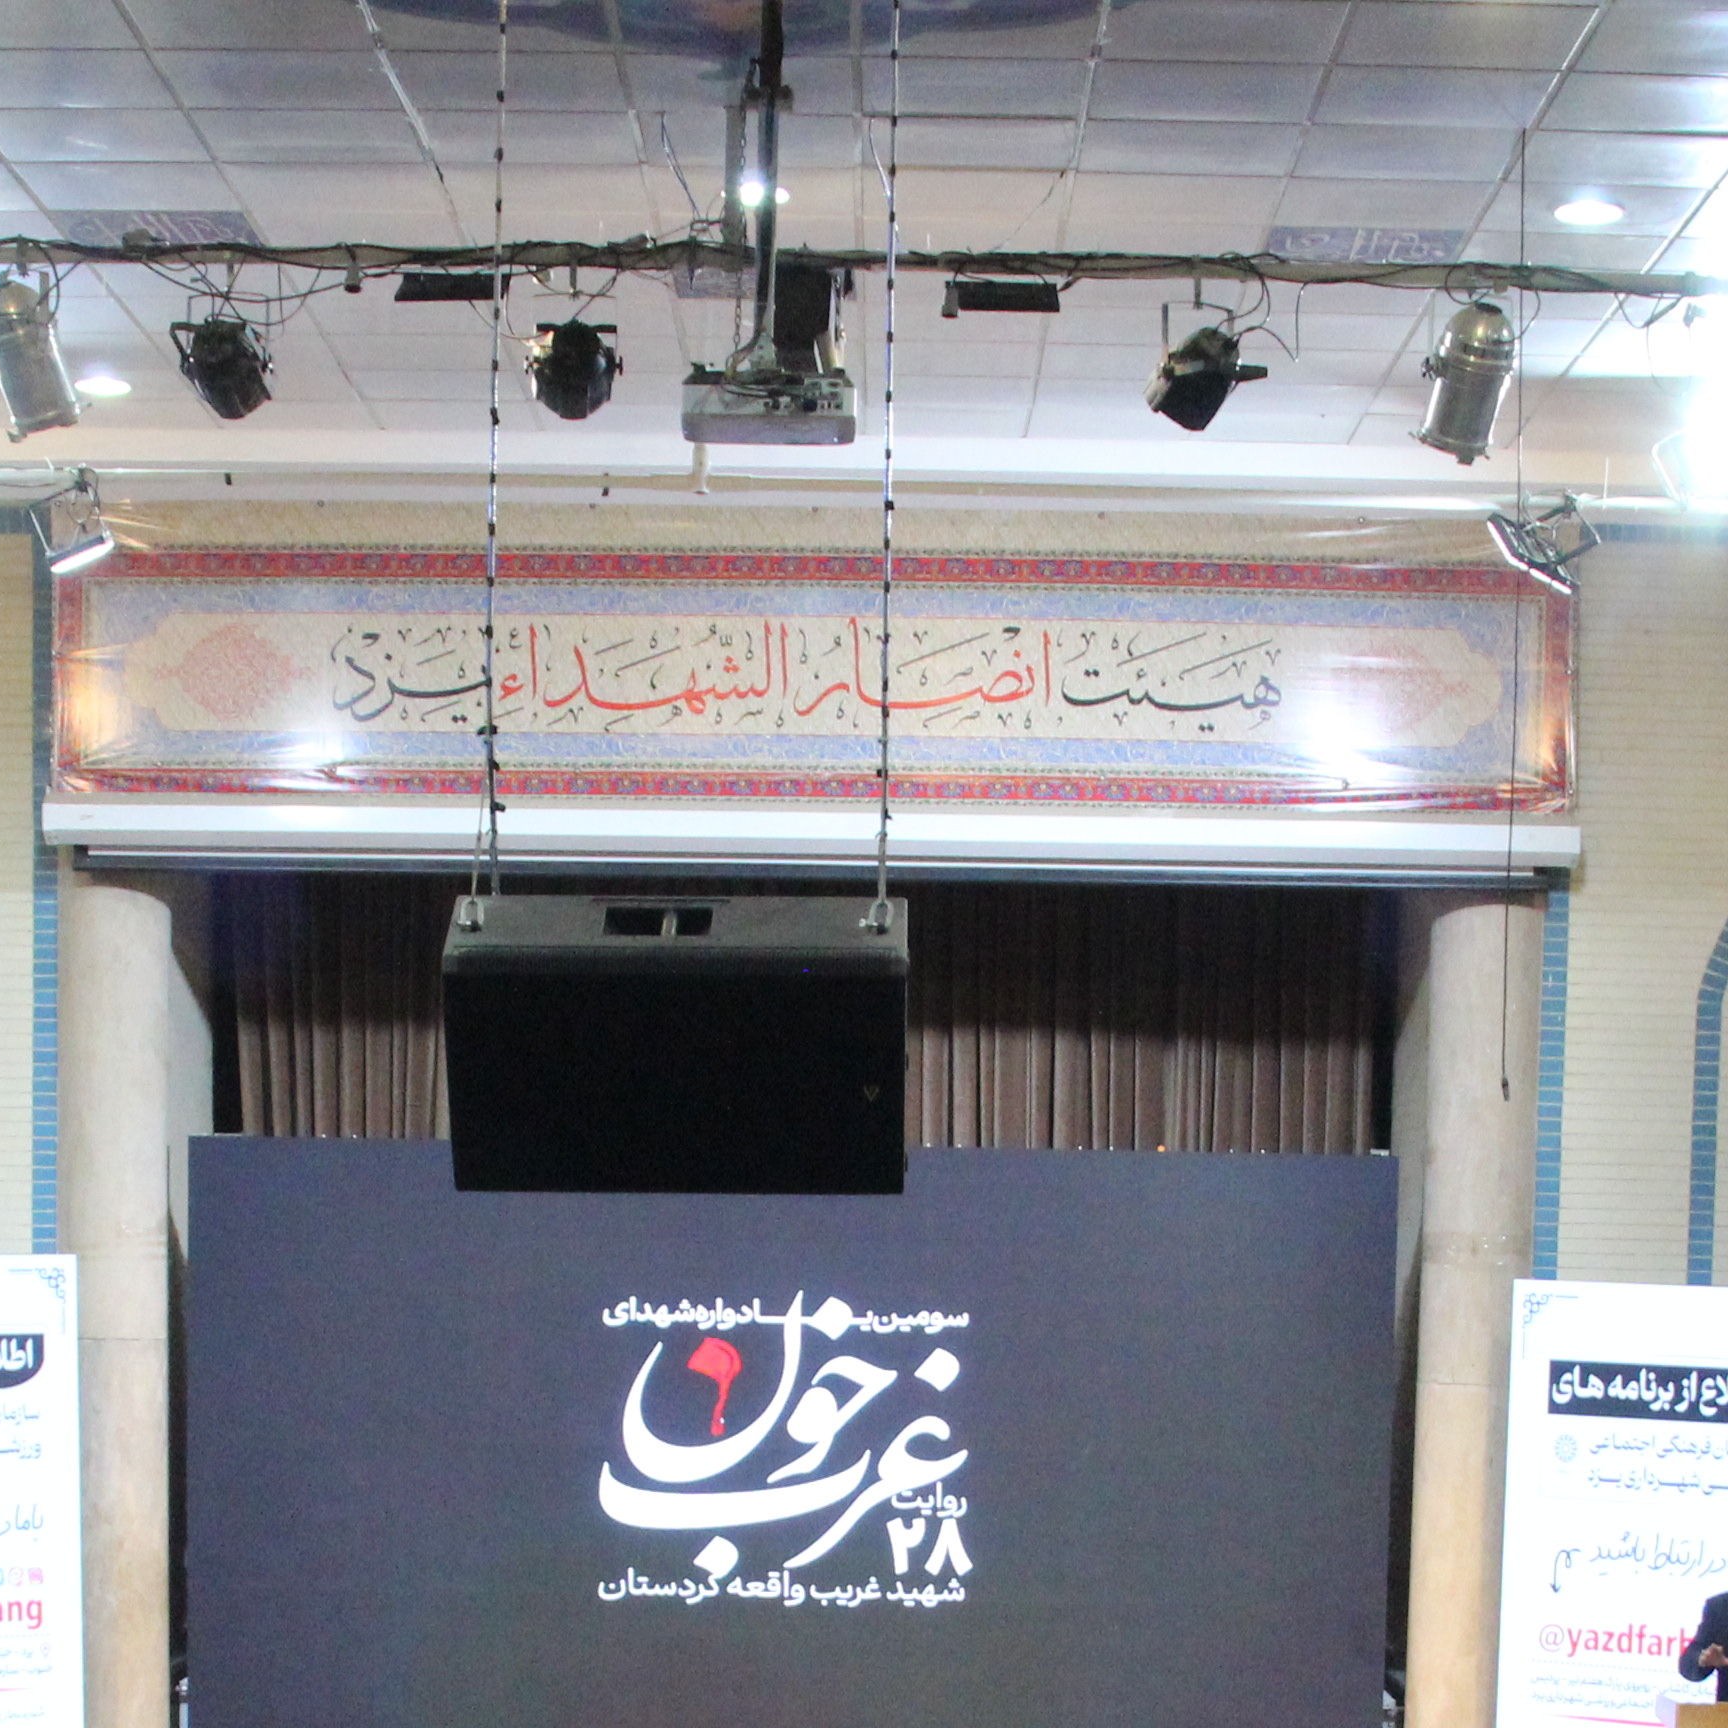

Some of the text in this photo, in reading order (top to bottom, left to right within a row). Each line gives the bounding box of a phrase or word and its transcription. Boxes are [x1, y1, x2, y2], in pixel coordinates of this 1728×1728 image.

[332, 652, 491, 724] یزد
[498, 622, 789, 716] الشهداء
[793, 616, 1054, 717] انصار
[602, 1295, 694, 1329] شهدای
[872, 1309, 970, 1334] سومین
[1551, 1364, 1605, 1404] های
[1607, 1367, 1674, 1412] برنامه
[1674, 1370, 1698, 1413] از
[890, 1480, 968, 1517] روایت
[885, 1516, 973, 1576] ۲۸
[597, 1566, 966, 1608] شهید غریب واقعه کردستان
